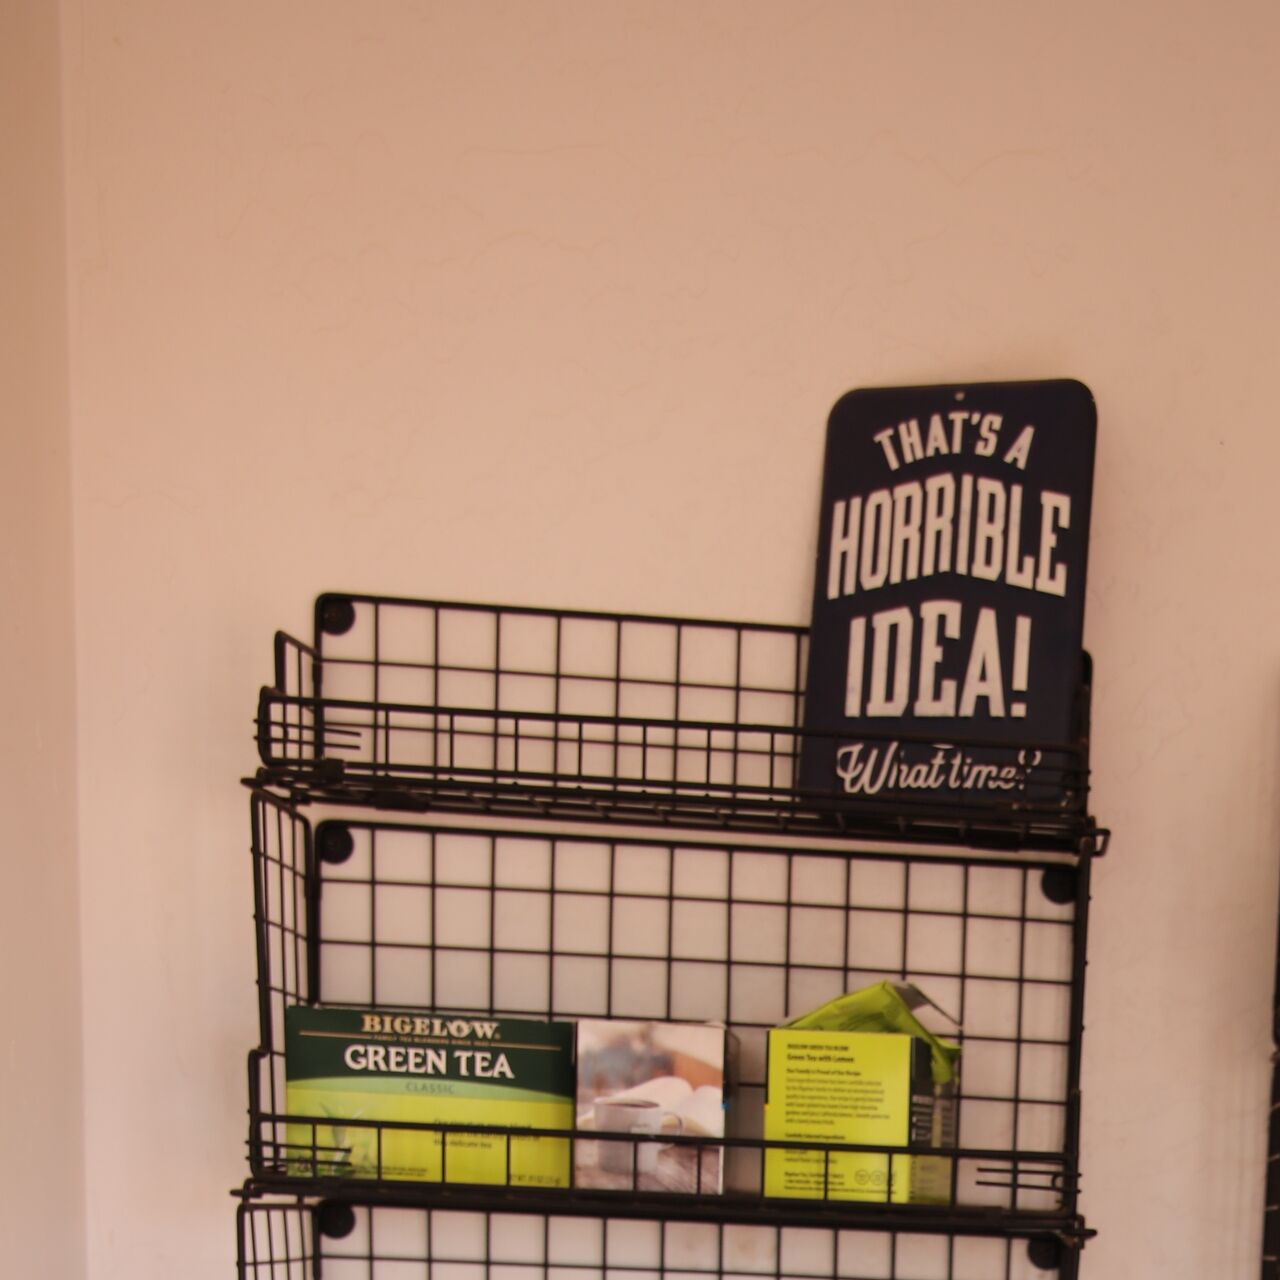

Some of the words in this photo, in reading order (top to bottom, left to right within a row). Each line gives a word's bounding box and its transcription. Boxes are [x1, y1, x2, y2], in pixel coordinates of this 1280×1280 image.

[873, 410, 1003, 471] THAT'S
[1004, 424, 1036, 471] A
[827, 472, 1072, 601] HORRIBLE
[844, 600, 1032, 719] IDEA!
[836, 741, 949, 796] What
[361, 1014, 499, 1039] BIGELOW
[344, 1044, 448, 1075] GREEN
[454, 1050, 515, 1079] TEA
[405, 1081, 455, 1095] CLASSIC
